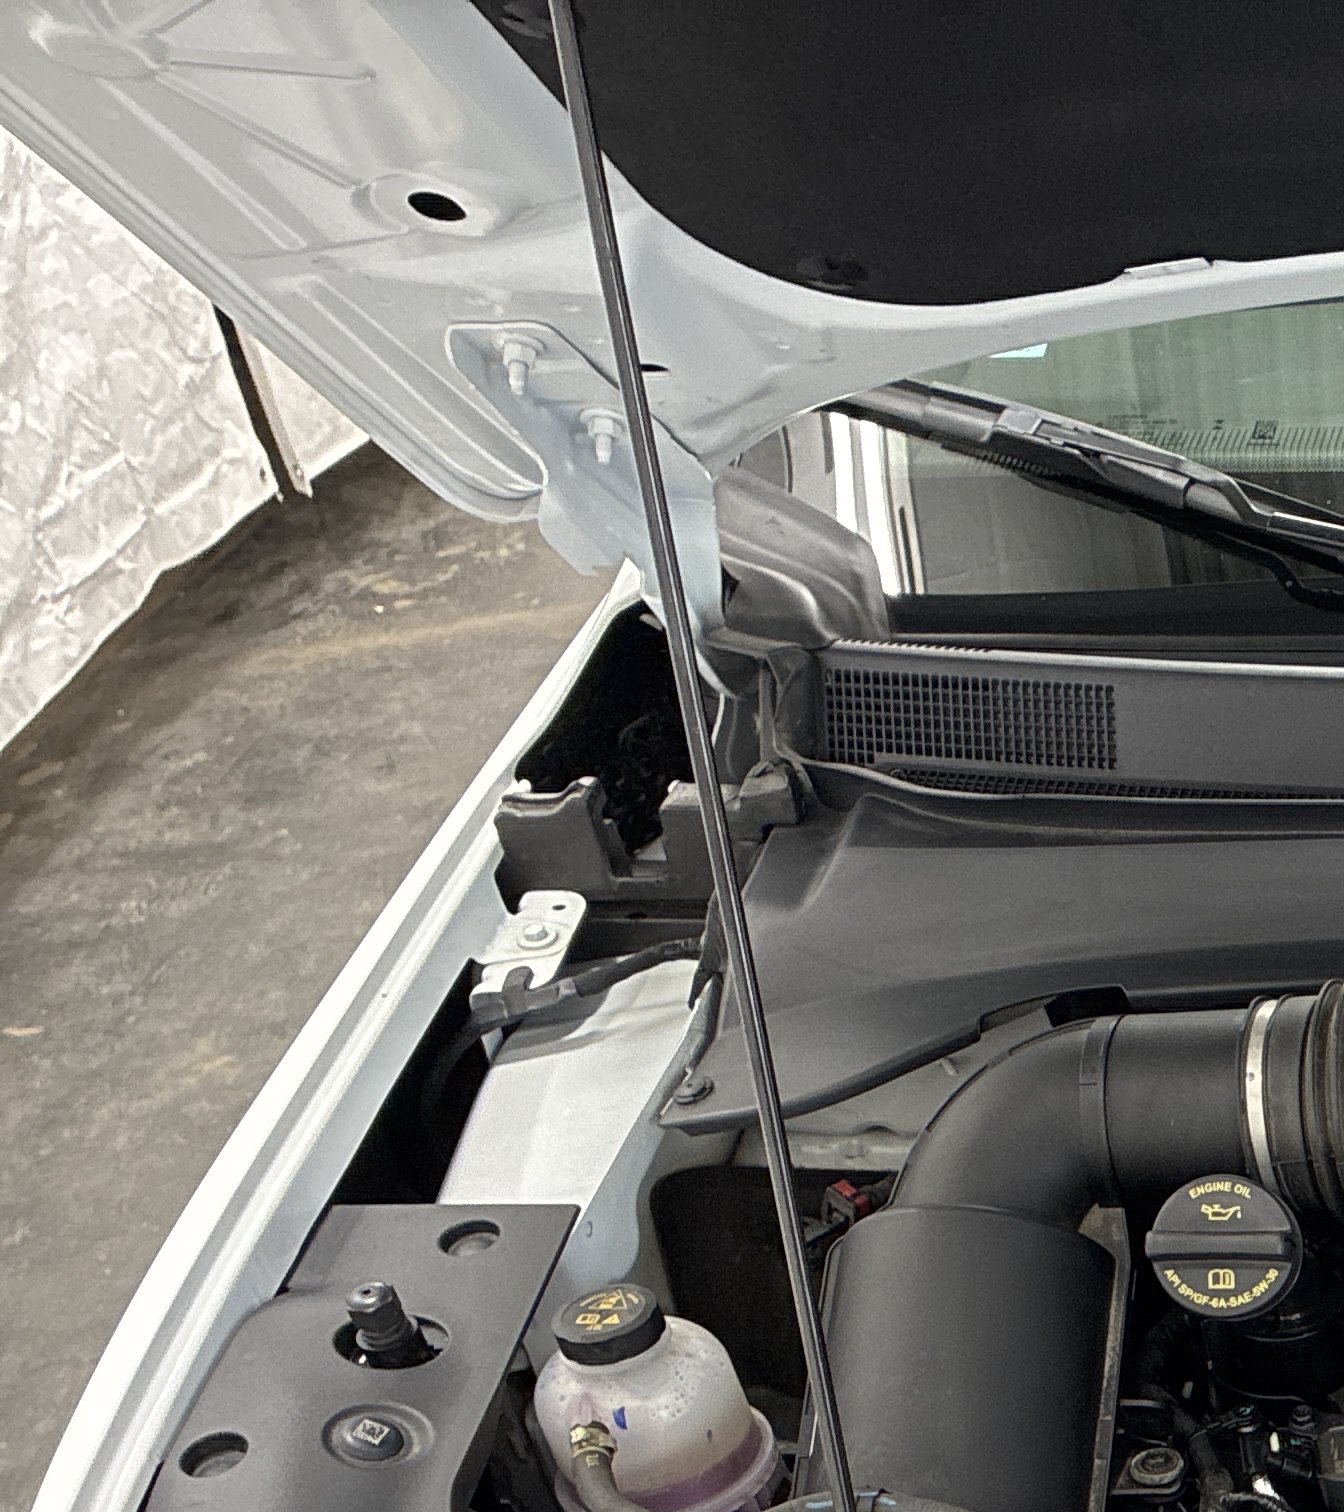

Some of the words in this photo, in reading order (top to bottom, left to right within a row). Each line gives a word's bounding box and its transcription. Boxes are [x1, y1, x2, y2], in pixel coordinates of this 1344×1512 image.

[1188, 1181, 1233, 1200] ENGINE
[1233, 1183, 1252, 1199] OIL
[1164, 1268, 1182, 1289] API
